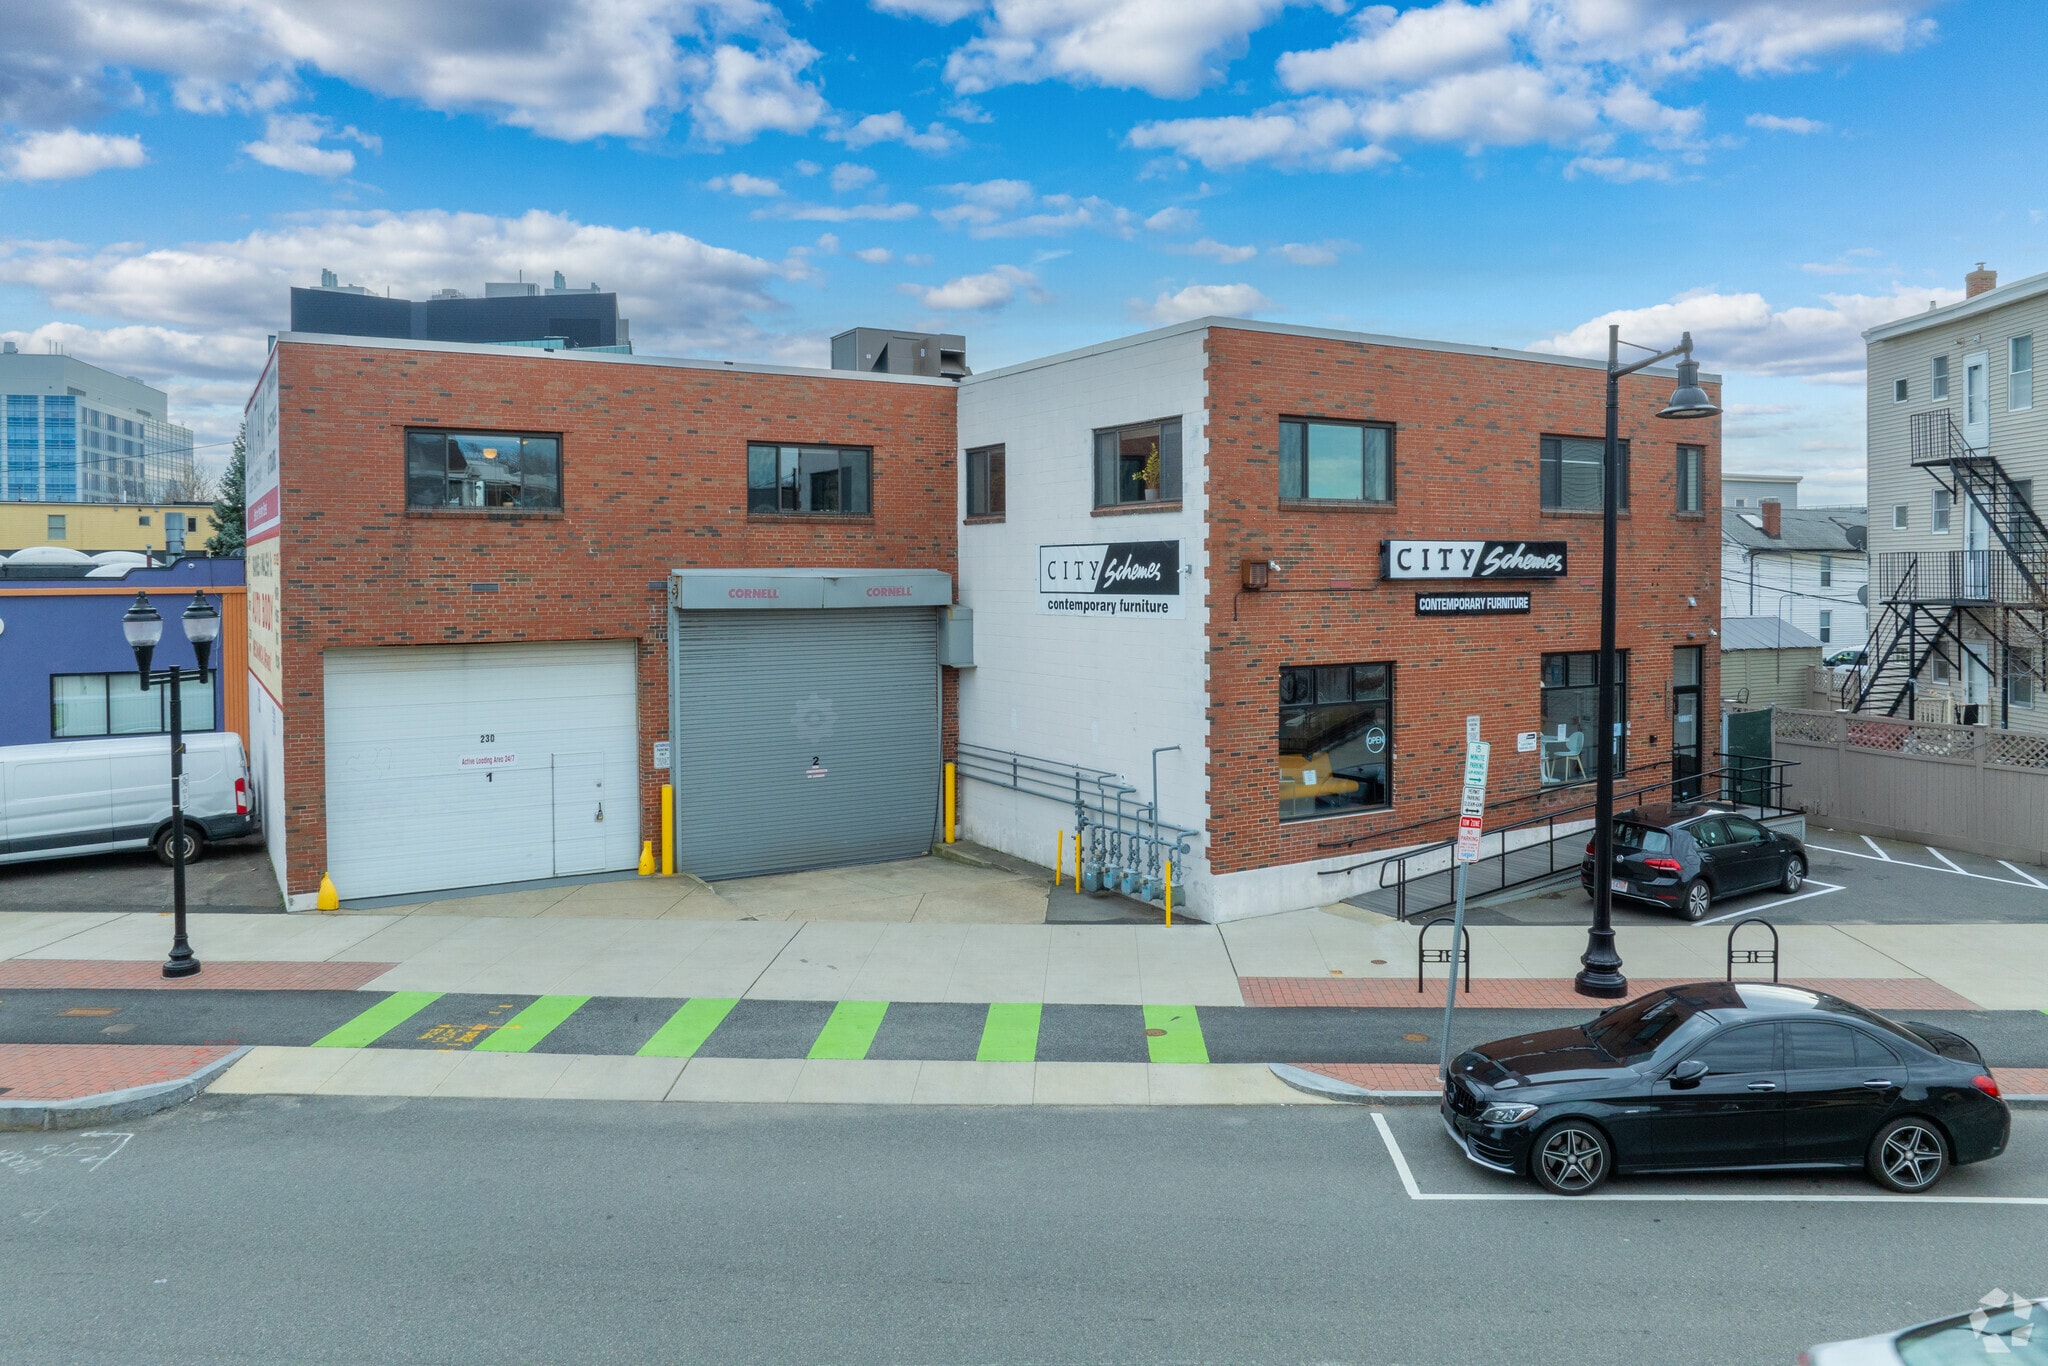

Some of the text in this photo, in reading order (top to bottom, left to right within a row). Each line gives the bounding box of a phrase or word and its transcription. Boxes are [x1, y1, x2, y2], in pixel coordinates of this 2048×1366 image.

[1397, 543, 1562, 576] CITY Schemes
[1047, 553, 1161, 589] CITY Schemes
[728, 588, 779, 599] CORNELL
[866, 586, 912, 598] CORNELL
[1047, 599, 1169, 615] contemporary furniture
[1419, 596, 1529, 611] CONTEMPORARY FURNITURE
[480, 734, 495, 743] 230
[1367, 735, 1385, 745] OPEN
[476, 757, 493, 765] Loading
[504, 755, 515, 763] 24/7
[812, 756, 820, 766] 2
[1469, 762, 1485, 770] PARKING
[486, 772, 493, 782] 1
[1461, 818, 1481, 828] TOW ZONE
